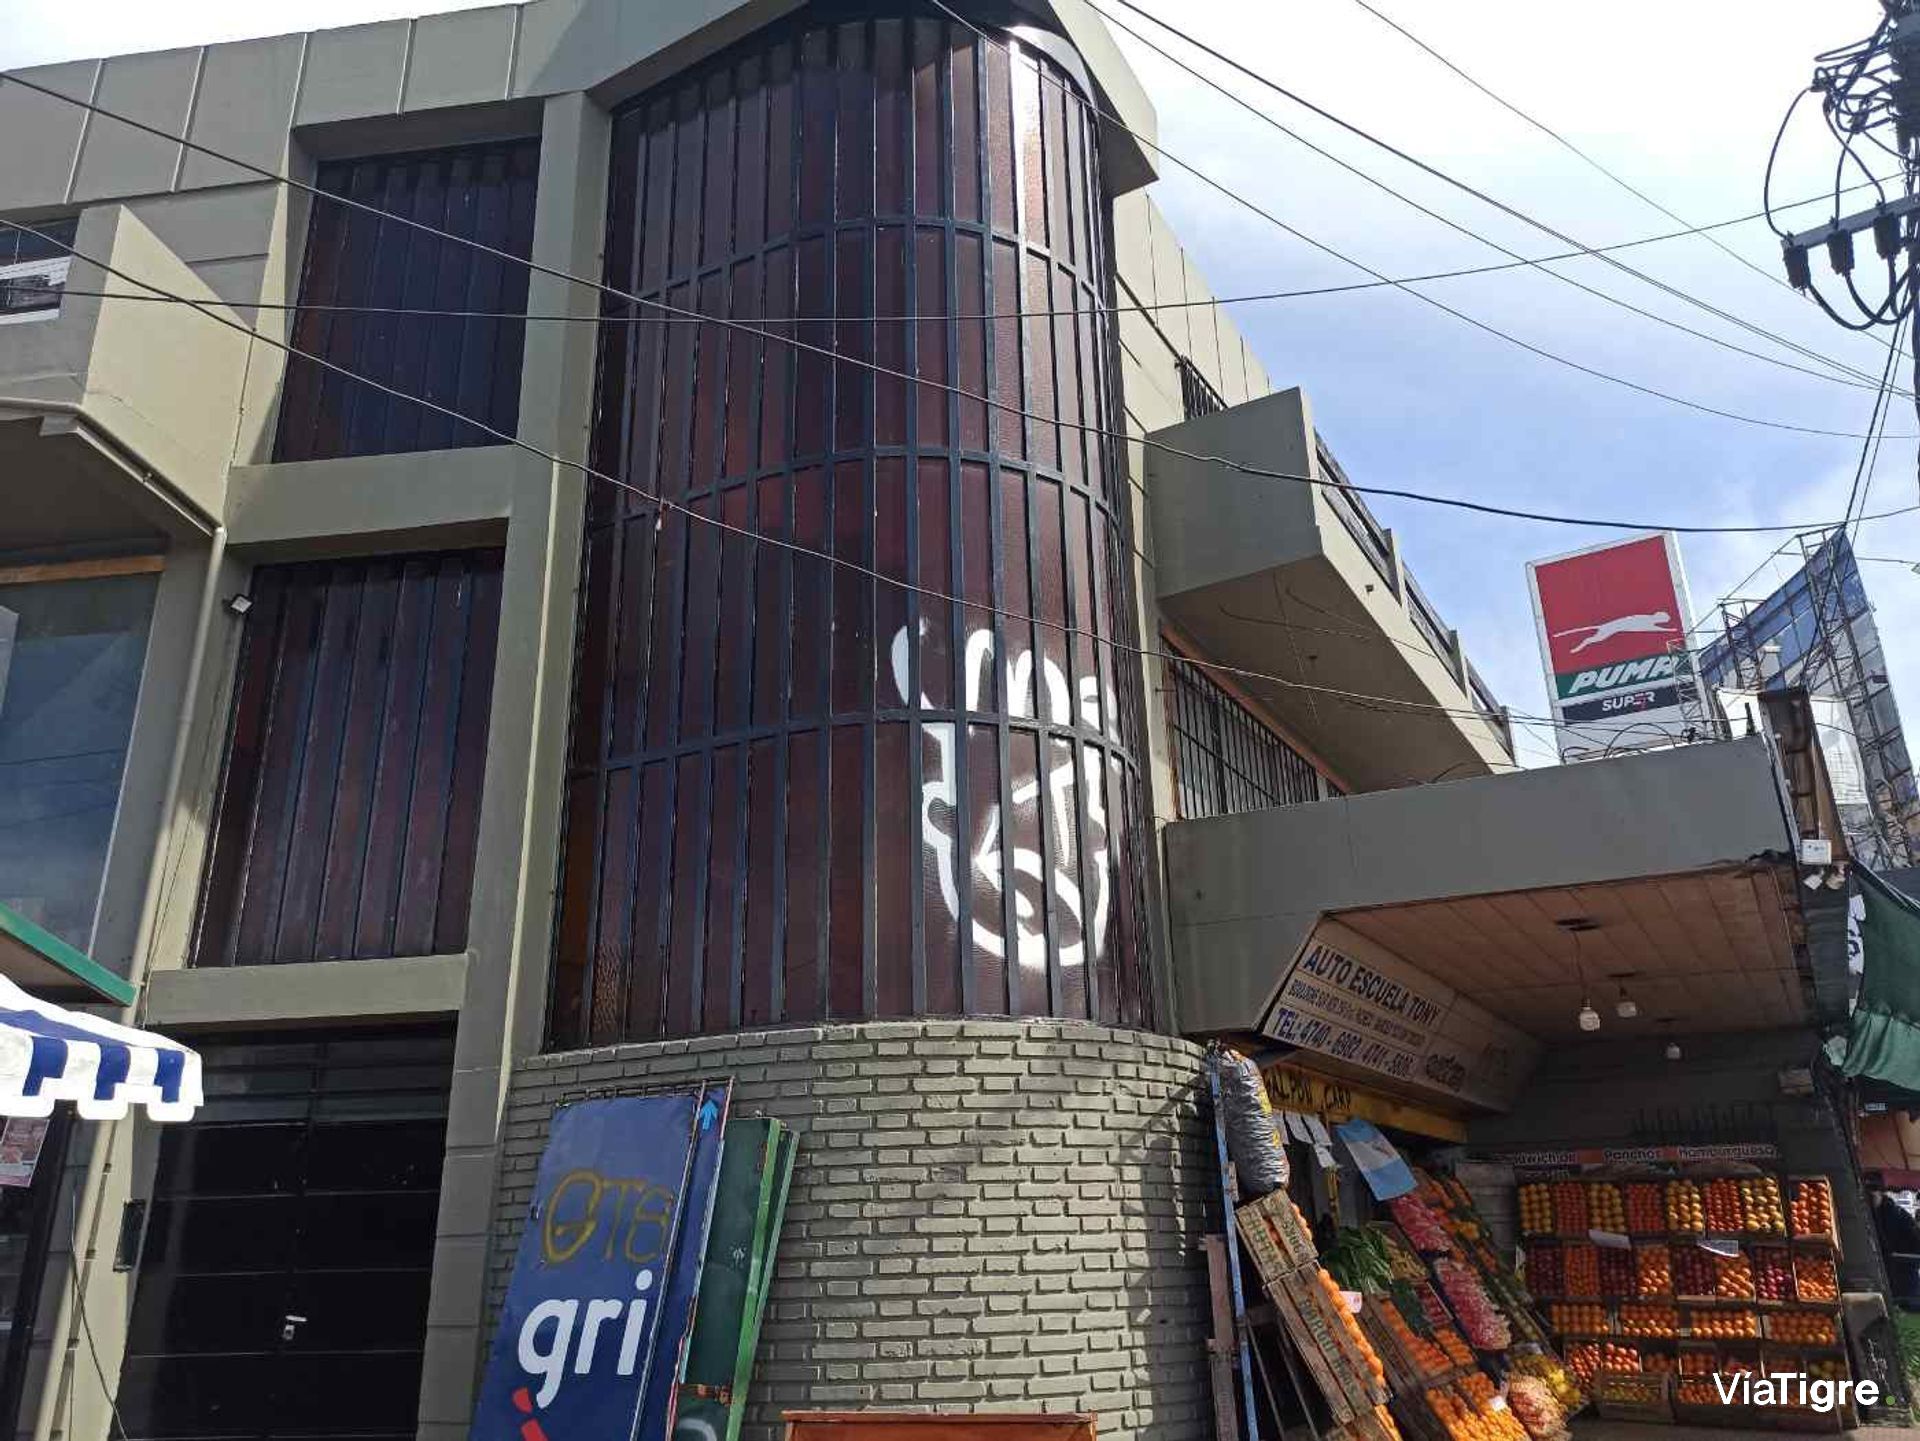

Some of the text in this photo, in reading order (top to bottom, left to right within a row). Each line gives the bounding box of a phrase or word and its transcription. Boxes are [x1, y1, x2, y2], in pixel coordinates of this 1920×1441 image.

[1569, 655, 1680, 694] PUMA
[1602, 690, 1656, 712] SUPER
[1303, 944, 1353, 983] AUTO
[1349, 965, 1410, 1013] ESCUELA
[1407, 996, 1440, 1025] TONY
